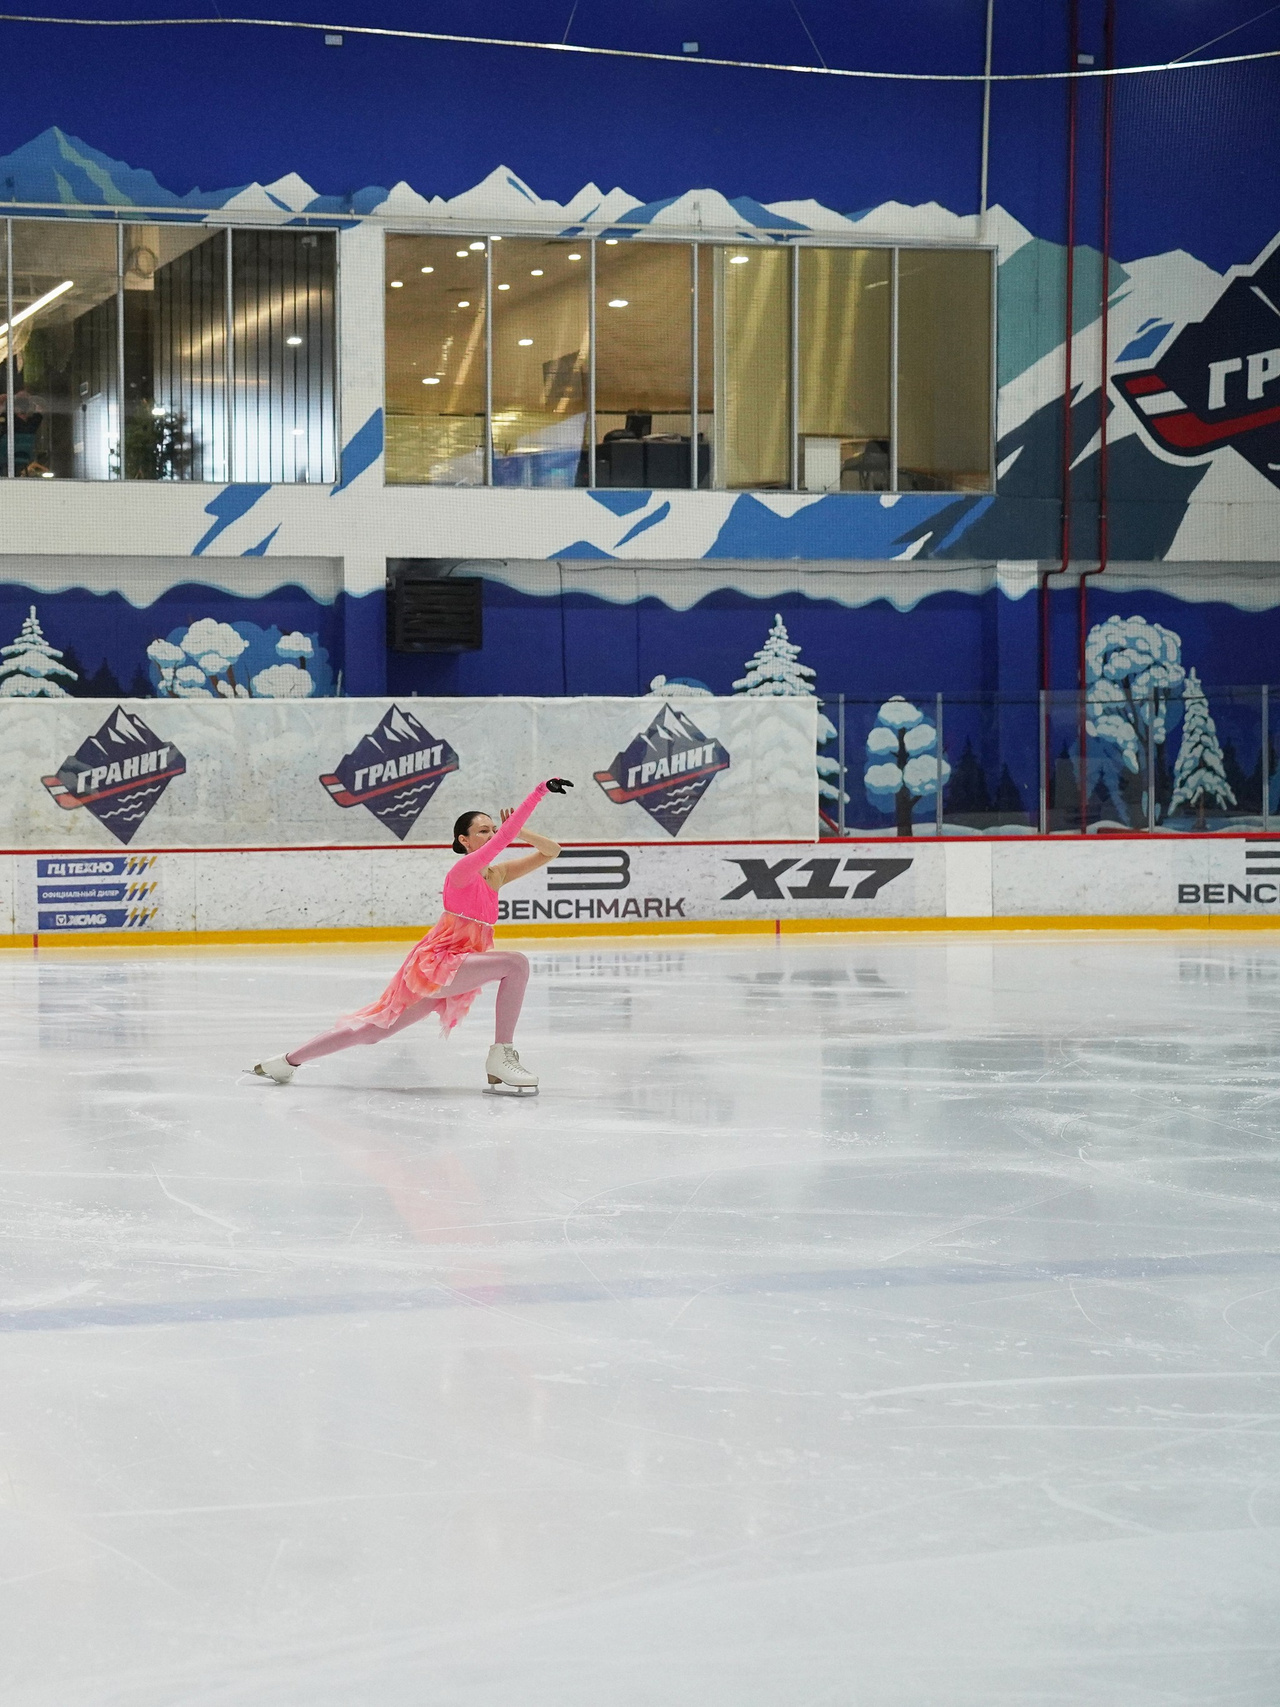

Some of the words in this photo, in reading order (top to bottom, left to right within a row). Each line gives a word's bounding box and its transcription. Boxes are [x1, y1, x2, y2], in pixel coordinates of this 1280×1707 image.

[76, 746, 170, 794] ГРАНИТ
[354, 744, 443, 791] ГРАНИТ
[627, 742, 715, 789] ГРАНИТ
[47, 863, 66, 876] ГЦ
[67, 861, 115, 875] ТЕХНО
[720, 858, 914, 900] X17
[42, 889, 97, 899] ОФИЦИАЛЬНЫЙ
[97, 889, 120, 897] ДИЛЕР
[1178, 883, 1280, 904] BENC
[67, 913, 107, 925] XCMG
